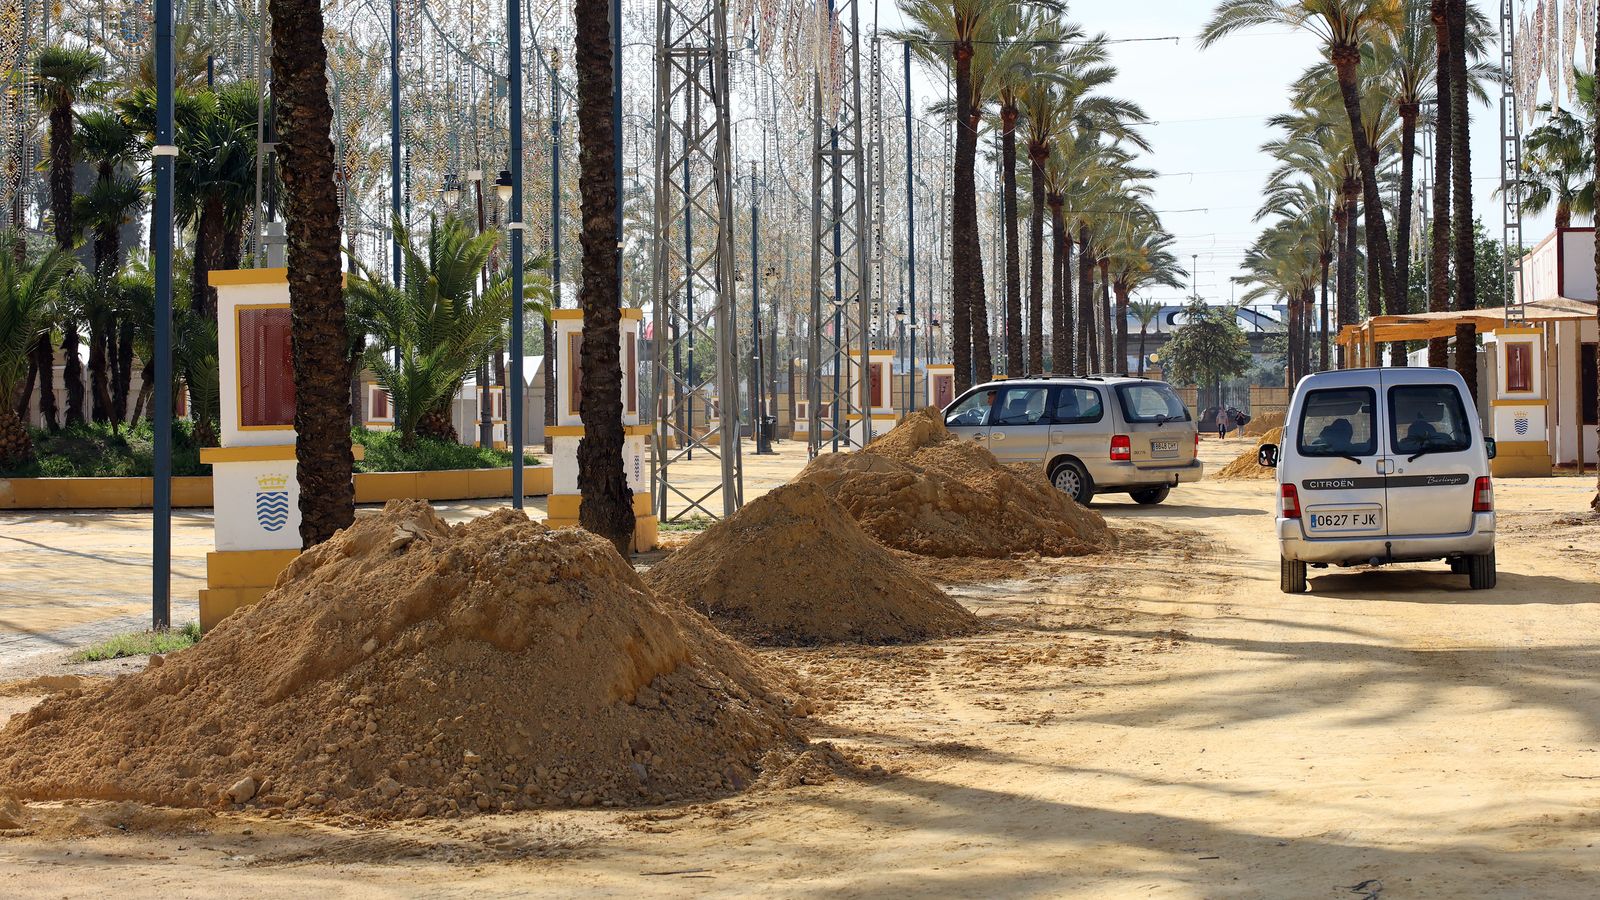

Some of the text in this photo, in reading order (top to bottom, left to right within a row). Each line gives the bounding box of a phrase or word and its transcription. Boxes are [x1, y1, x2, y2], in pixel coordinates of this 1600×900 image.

[1309, 480, 1354, 488] CITROËN
[1426, 476, 1461, 485] Berlingo
[1317, 514, 1376, 526] 0627 FJK
